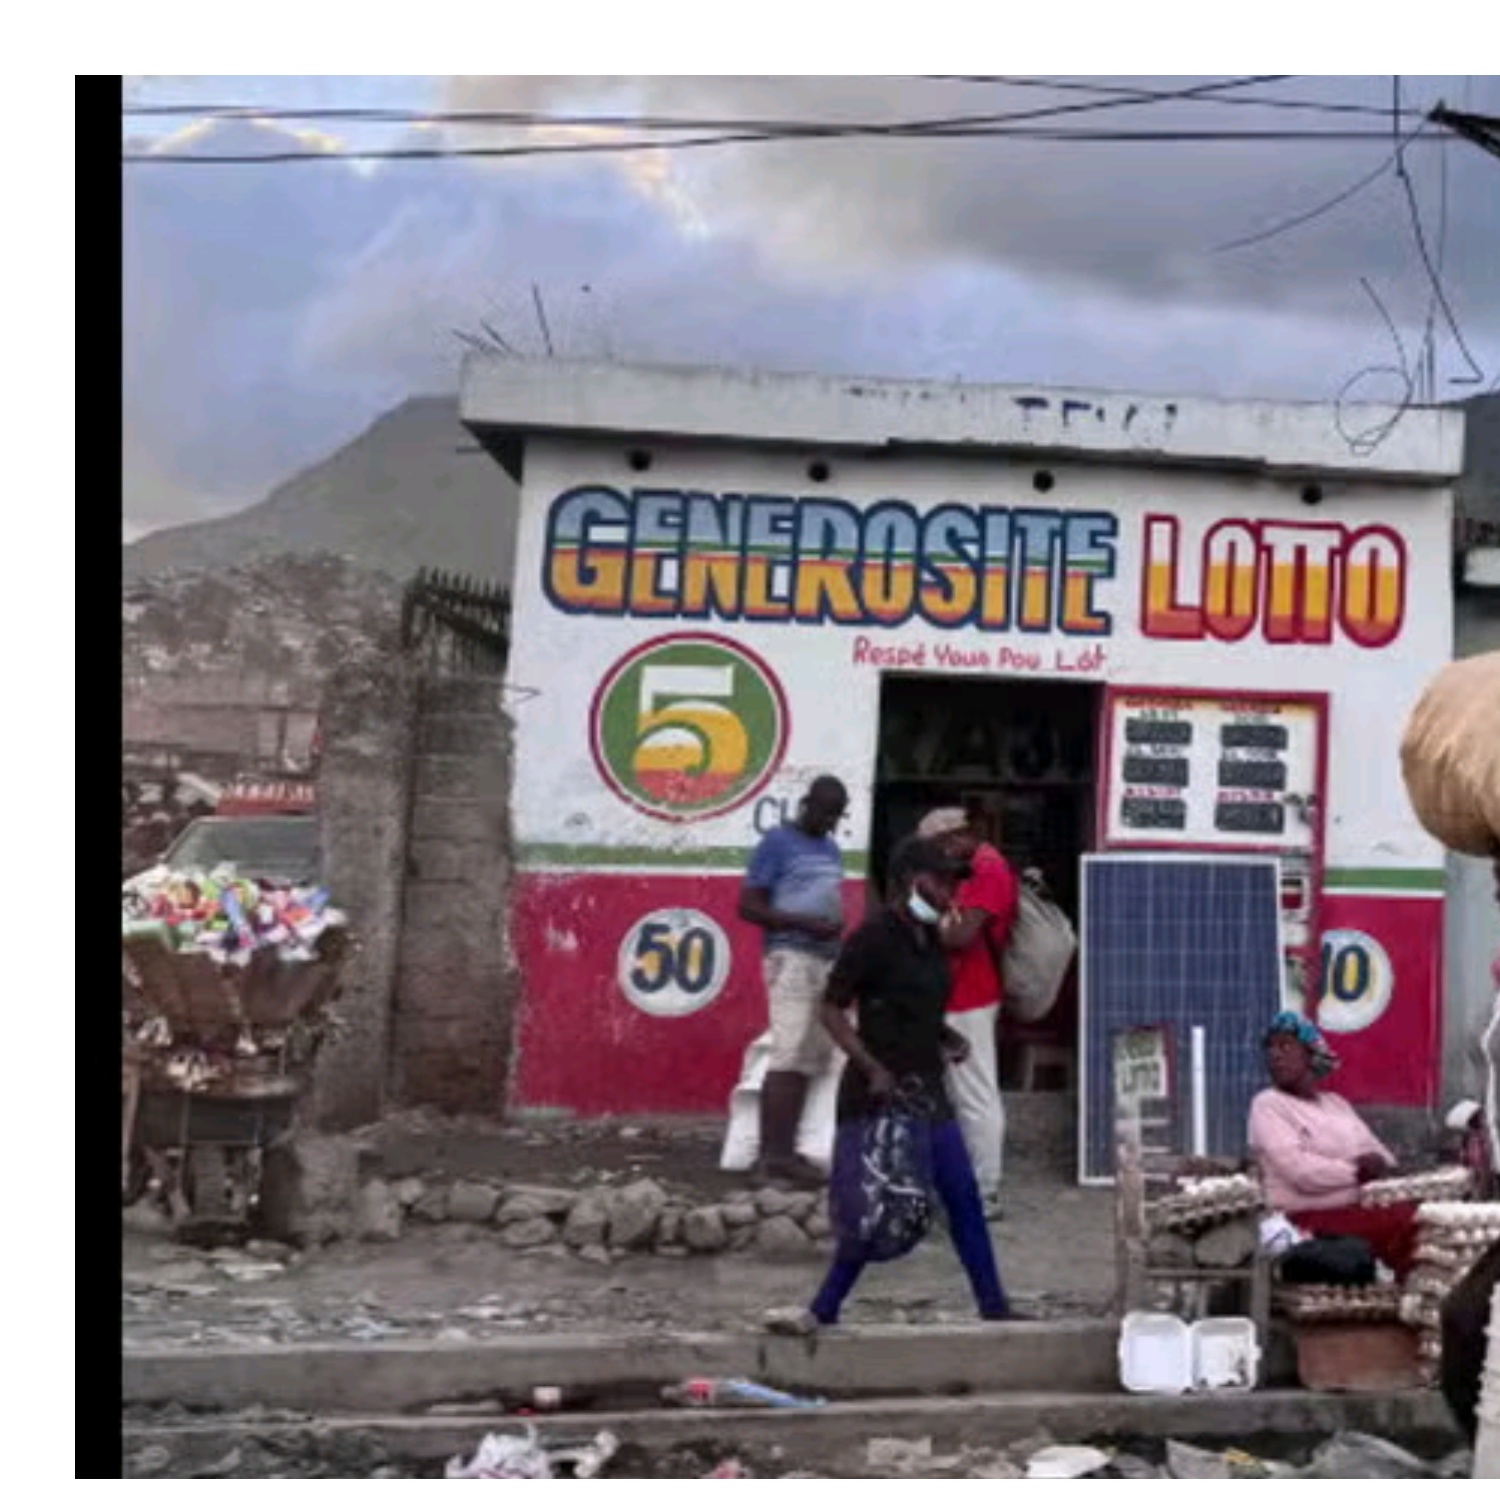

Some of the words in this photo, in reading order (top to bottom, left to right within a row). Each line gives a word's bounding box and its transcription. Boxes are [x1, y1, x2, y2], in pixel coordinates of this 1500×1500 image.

[542, 485, 1118, 636] GENEROSITE
[1140, 513, 1408, 647] LOTTO
[631, 664, 750, 804] 5
[630, 922, 716, 993] 50
